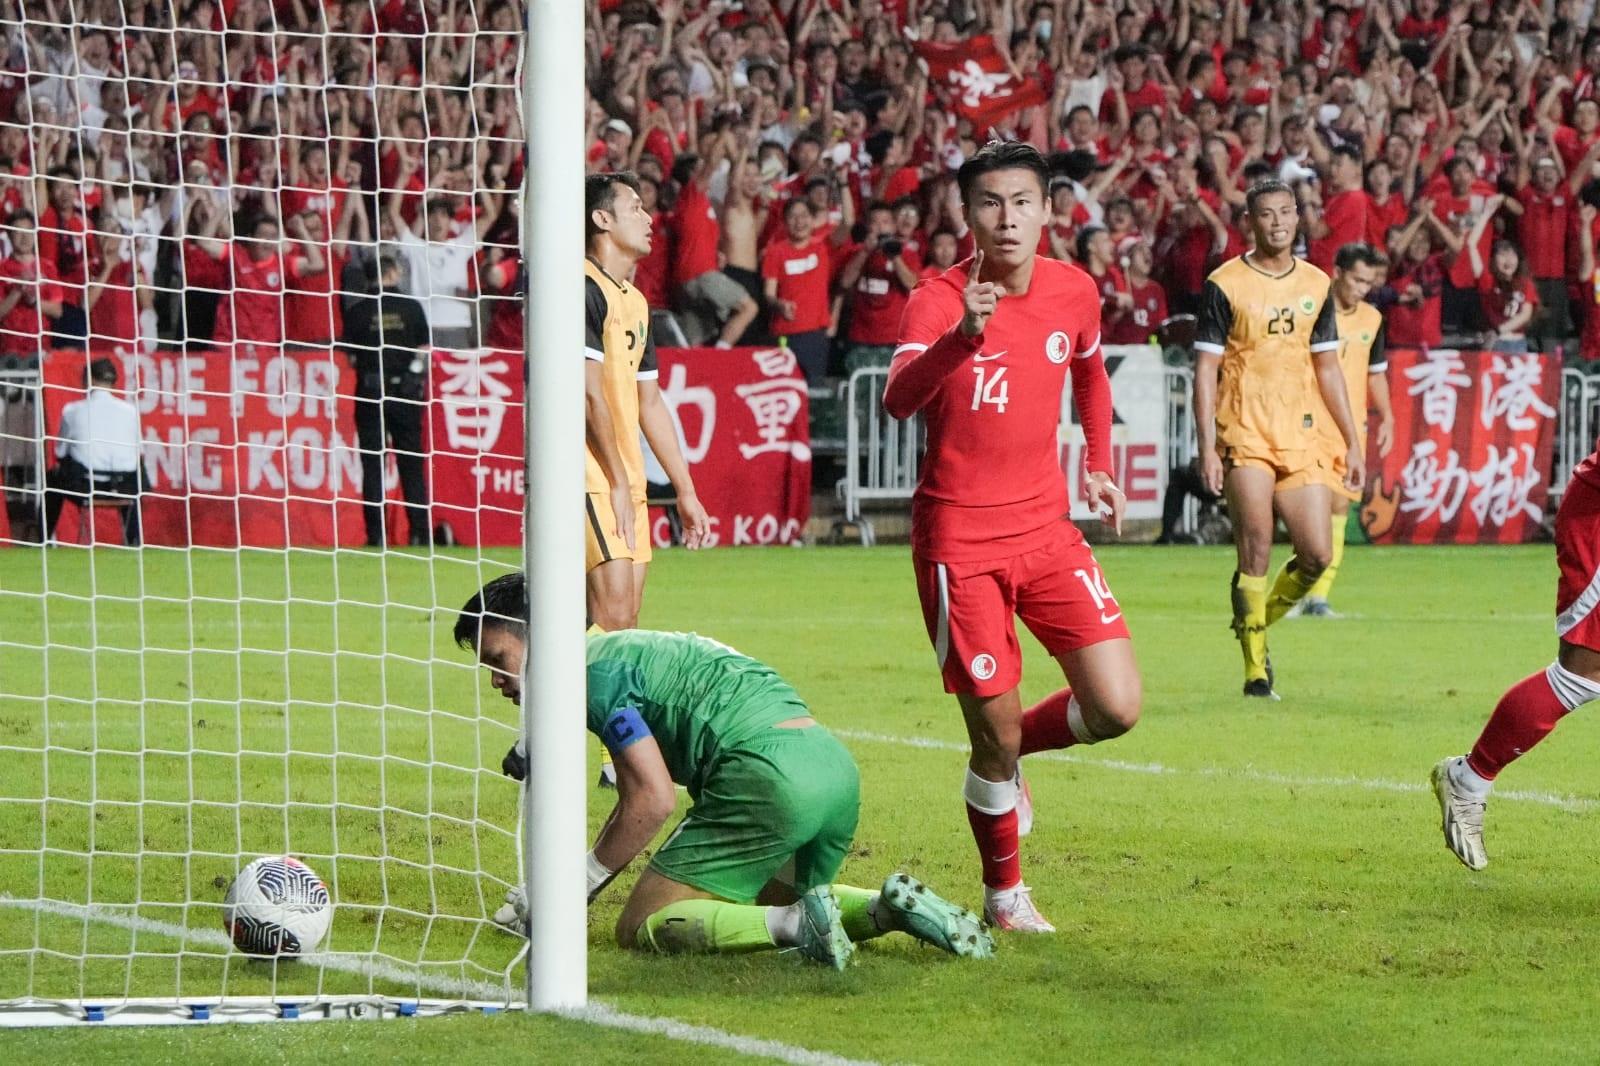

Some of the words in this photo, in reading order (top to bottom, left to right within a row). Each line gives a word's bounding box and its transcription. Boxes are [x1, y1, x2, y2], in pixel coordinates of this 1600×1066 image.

[1268, 308, 1295, 335] 23
[123, 353, 207, 417] DIE
[229, 356, 340, 418] FOR
[440, 347, 513, 452] 香
[971, 366, 1009, 413] 14
[1404, 349, 1557, 433] 香港
[609, 715, 634, 742] C
